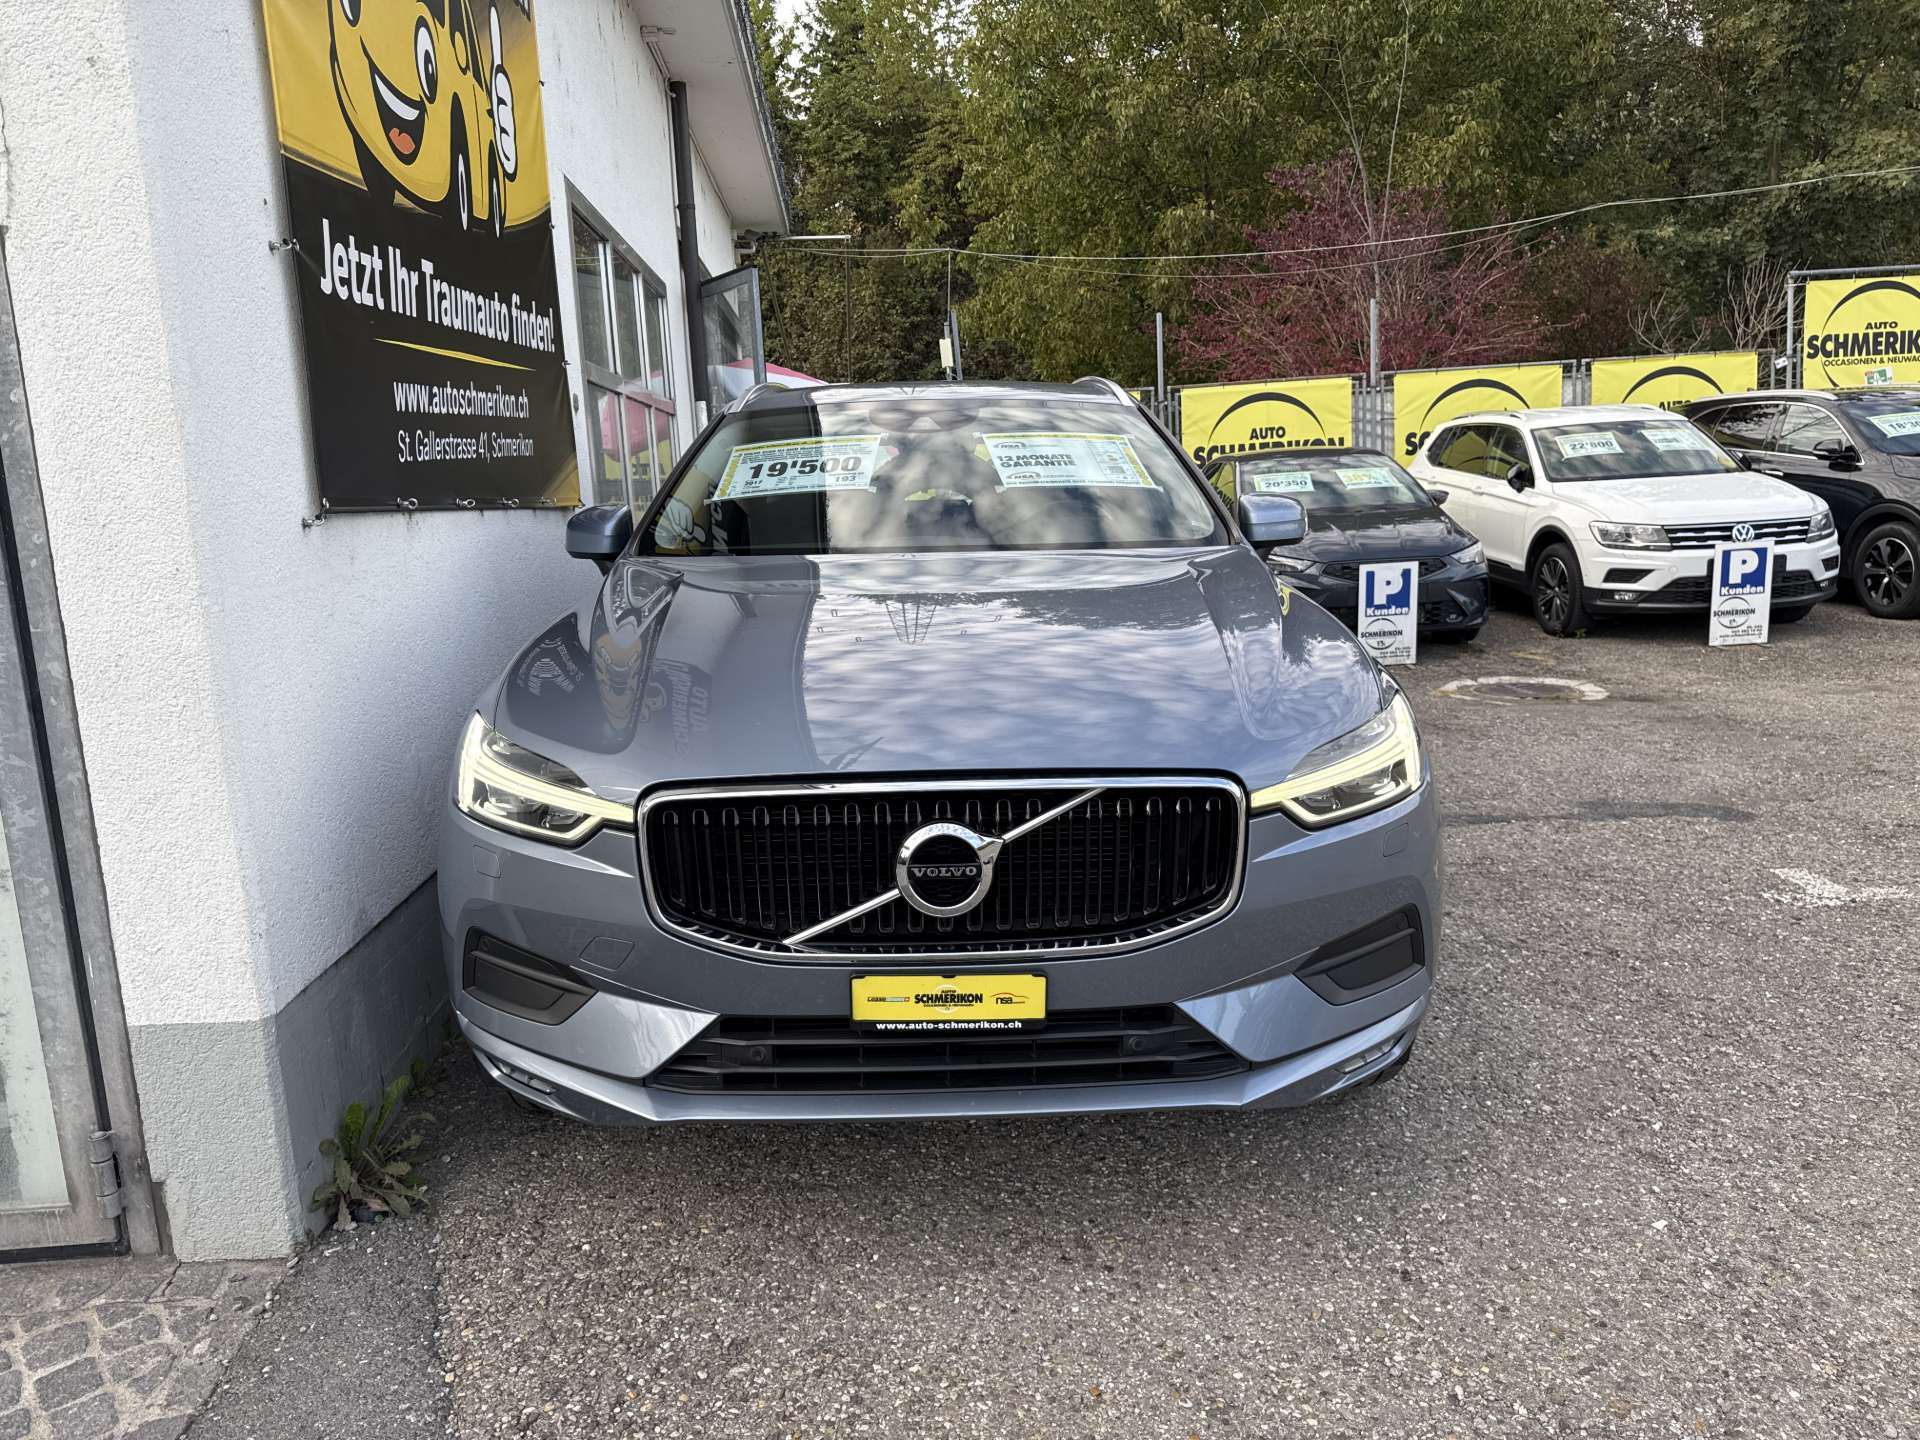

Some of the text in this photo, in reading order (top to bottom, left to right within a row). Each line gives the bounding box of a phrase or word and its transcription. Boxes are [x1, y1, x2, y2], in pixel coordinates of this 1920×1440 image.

[320, 217, 555, 353] Jetzt Ihr Traumauto finden!
[1865, 321, 1898, 330] AUTO
[1806, 329, 1920, 359] SCHMERIK
[1824, 357, 1877, 367] OCCASIONEN
[1879, 357, 1886, 365] &
[393, 381, 529, 418] www.autoschmerikon.ch
[1250, 426, 1286, 440] AUTO
[397, 429, 534, 463] St. Gallerstrasse 41, Schmerikon
[750, 456, 862, 479] 19'500
[1000, 460, 1077, 468] GARANTIE
[1729, 549, 1759, 584] P
[1374, 567, 1403, 605] P
[1721, 584, 1764, 596] Kunden
[1366, 605, 1410, 617] Kunden
[1713, 608, 1756, 618] SCHMERIKON
[1361, 630, 1403, 639] SCHMERIKON
[911, 866, 977, 877] VOLVO
[914, 993, 983, 1004] SCHMERIKON
[876, 1021, 1022, 1030] www.auto-schmerikon.ch
